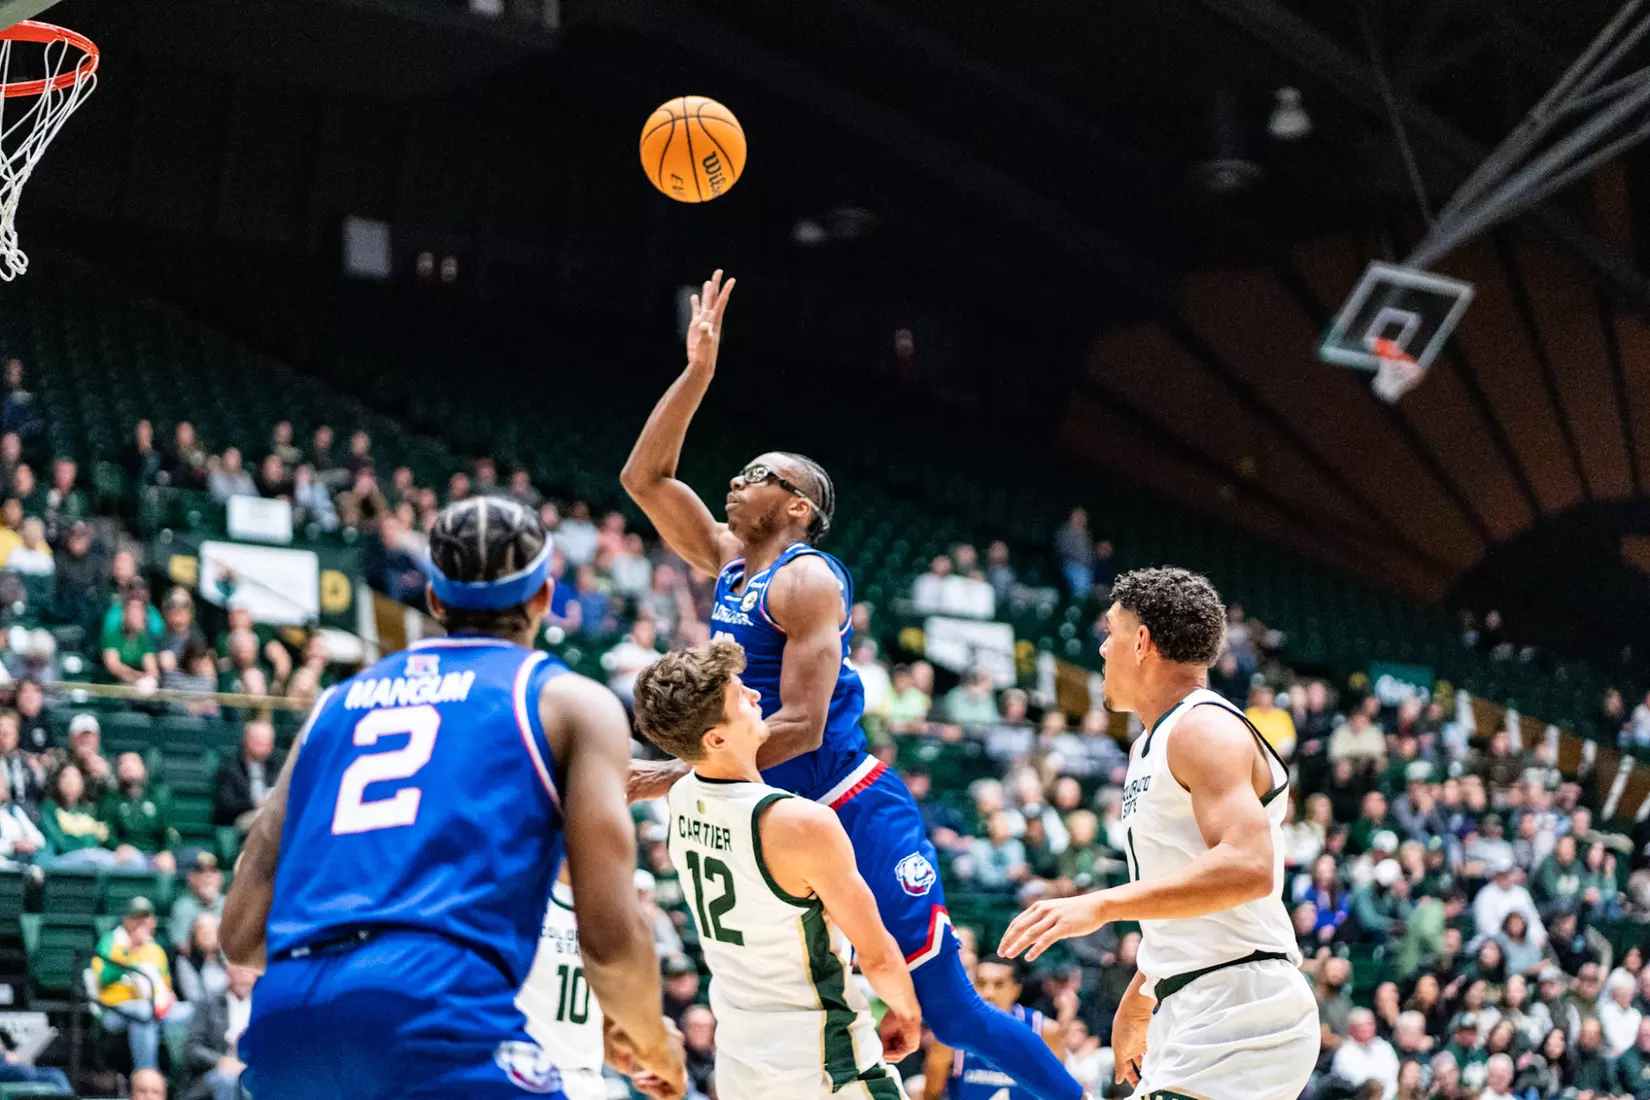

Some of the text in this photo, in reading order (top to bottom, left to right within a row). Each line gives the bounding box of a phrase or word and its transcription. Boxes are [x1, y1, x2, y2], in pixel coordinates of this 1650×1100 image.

[344, 669, 476, 711] MANGUM
[331, 703, 442, 836] 2
[679, 814, 732, 852] CARTIER
[685, 850, 745, 947] 12
[556, 964, 591, 1025] 10
